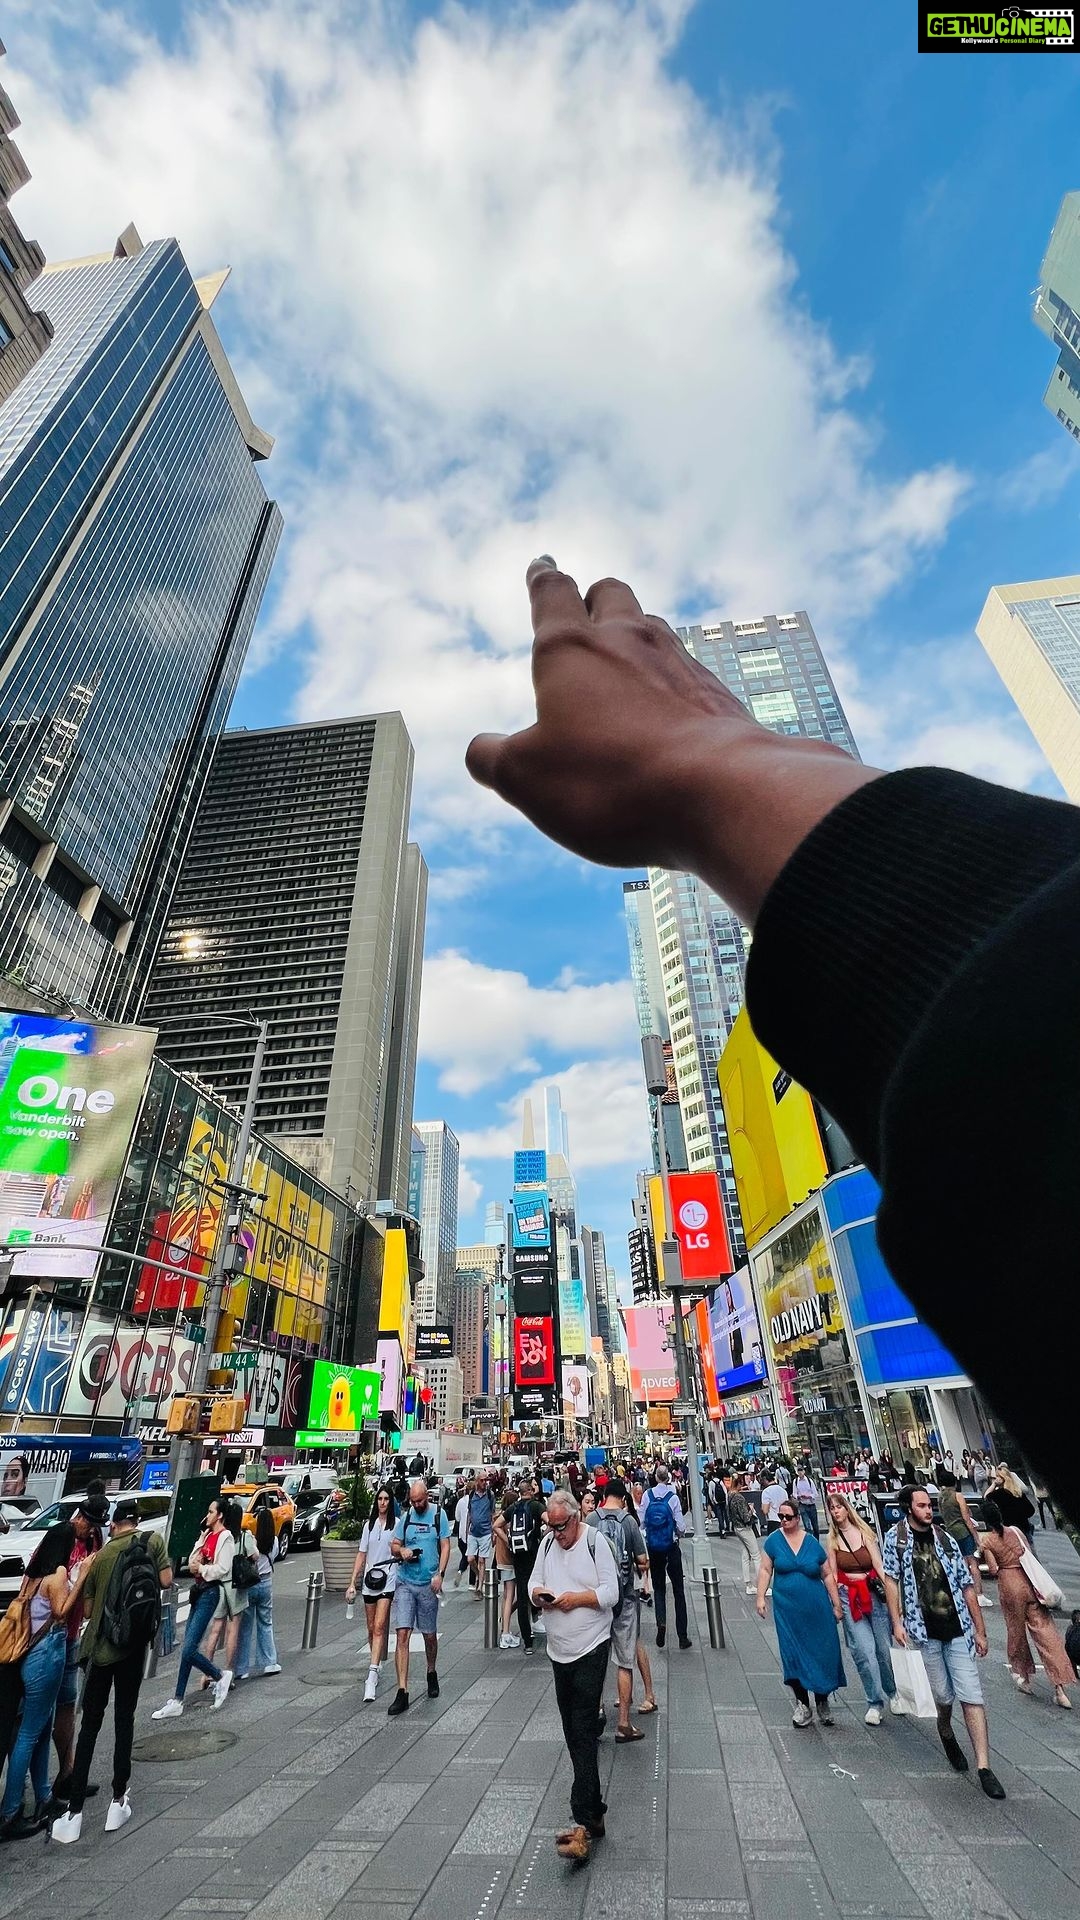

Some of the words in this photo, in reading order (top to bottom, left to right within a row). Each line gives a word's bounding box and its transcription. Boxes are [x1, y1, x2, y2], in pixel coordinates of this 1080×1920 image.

[18, 1075, 115, 1114] One
[10, 1109, 87, 1128] Vanderbilt
[38, 1127, 80, 1141] open.
[408, 1161, 418, 1213] TIMES
[34, 1233, 67, 1243] Bank
[685, 1232, 710, 1249] LG
[515, 1254, 549, 1262] SAMSUNG
[772, 1312, 791, 1344] OLD
[790, 1294, 822, 1336] NAVY
[12, 1358, 27, 1386] CBS
[21, 1311, 40, 1356] NEWS
[520, 1346, 547, 1365] JOY
[223, 1355, 232, 1367] W
[235, 1353, 247, 1366] 44
[120, 1340, 194, 1402] CBS
